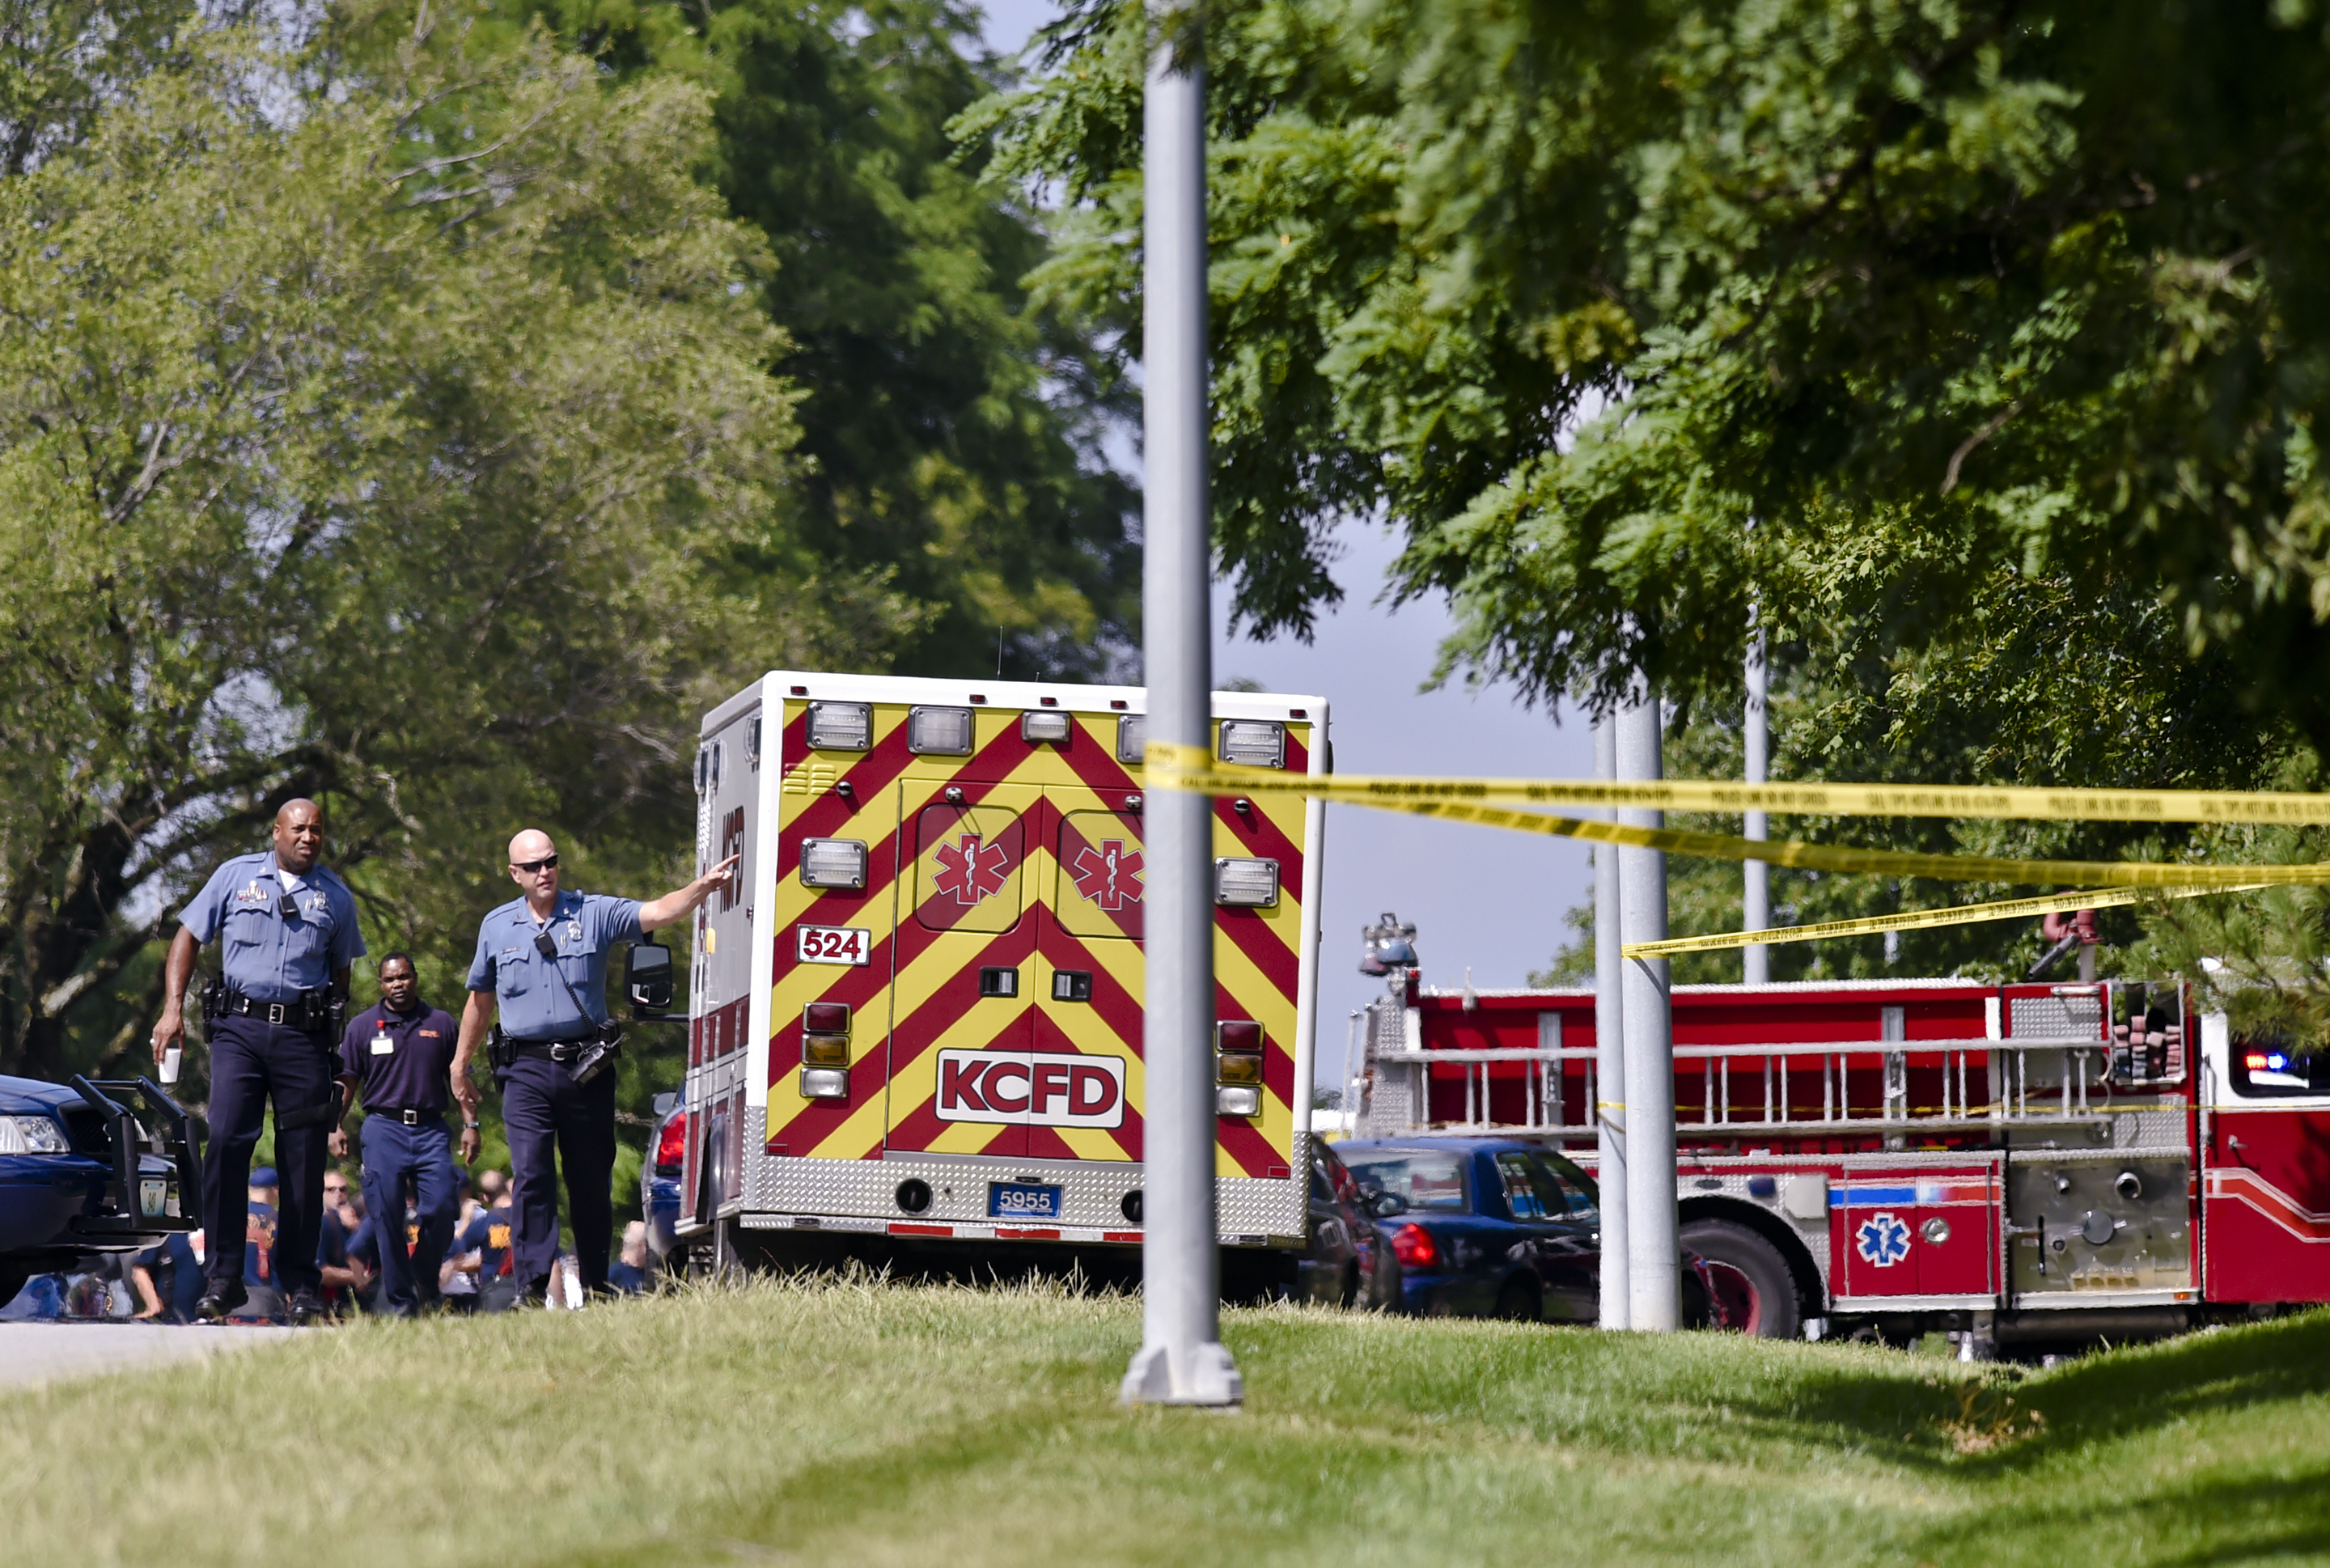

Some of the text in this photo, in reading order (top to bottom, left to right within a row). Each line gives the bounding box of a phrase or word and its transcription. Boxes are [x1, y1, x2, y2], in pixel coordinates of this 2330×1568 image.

[803, 931, 862, 959] 524
[941, 1059, 1119, 1116] KCFD
[999, 1191, 1051, 1209] 5955
